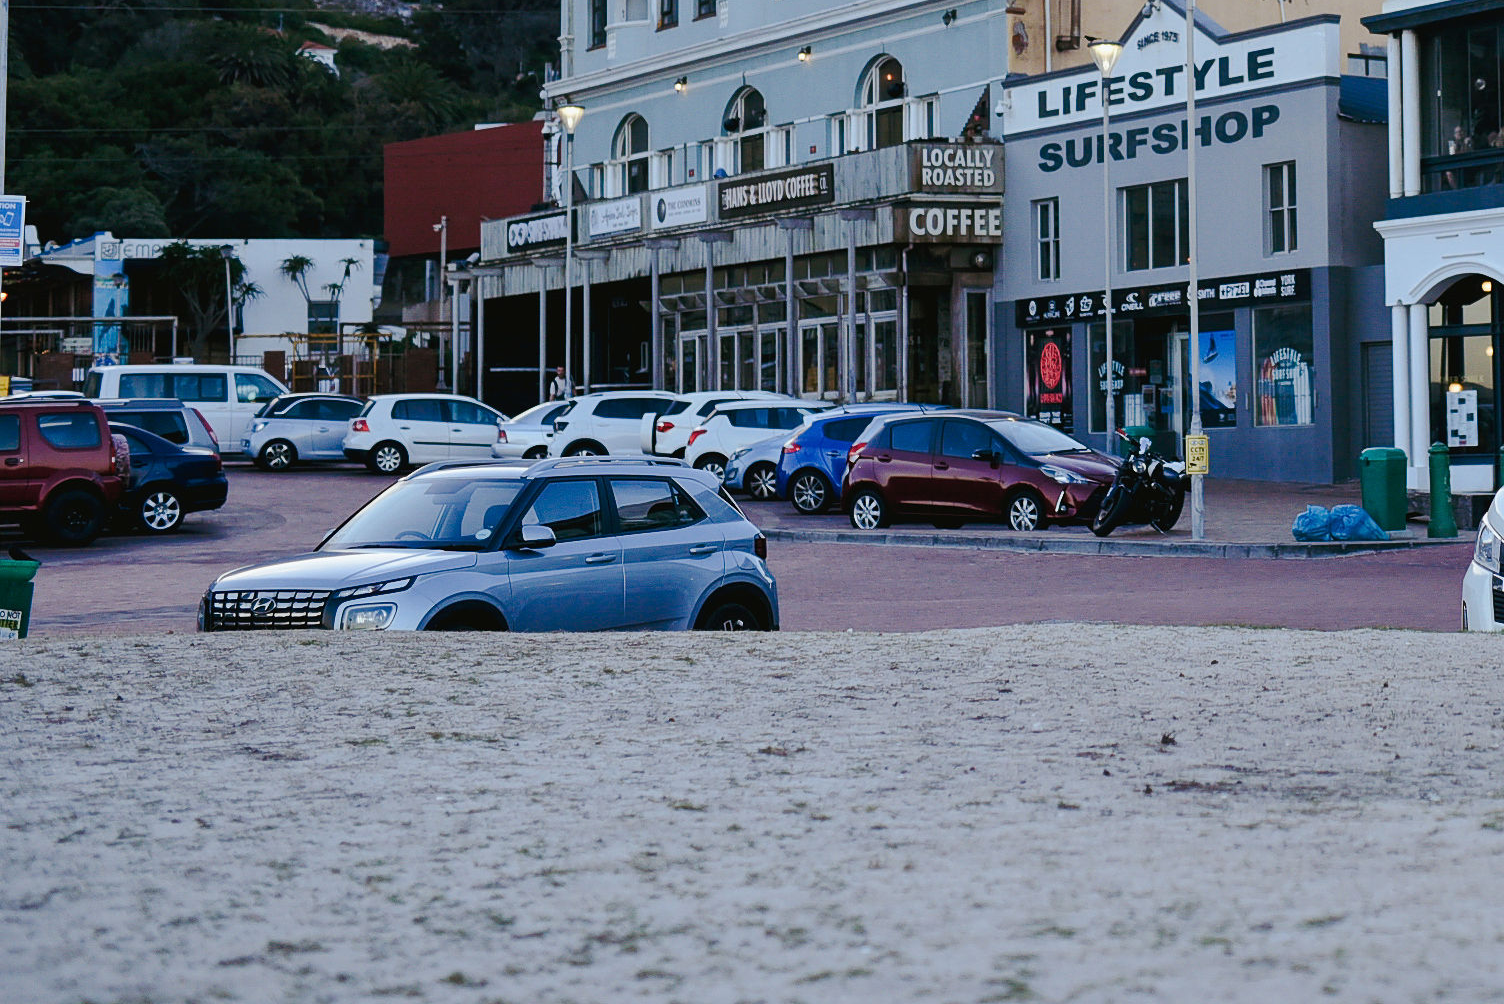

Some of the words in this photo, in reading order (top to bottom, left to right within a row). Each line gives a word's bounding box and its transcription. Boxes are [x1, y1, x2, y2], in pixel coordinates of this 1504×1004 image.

[1137, 31, 1160, 51] SINCE
[1038, 47, 1275, 118] LIFESTYLE
[1038, 104, 1280, 172] SURFSHOP
[922, 148, 994, 168] LOCALLY
[727, 185, 748, 209] HANS
[749, 184, 757, 206] &
[758, 179, 785, 204] LLOYD
[785, 174, 817, 199] COFFEE
[922, 167, 995, 187] ROASTED
[909, 207, 1001, 236] COFFEE
